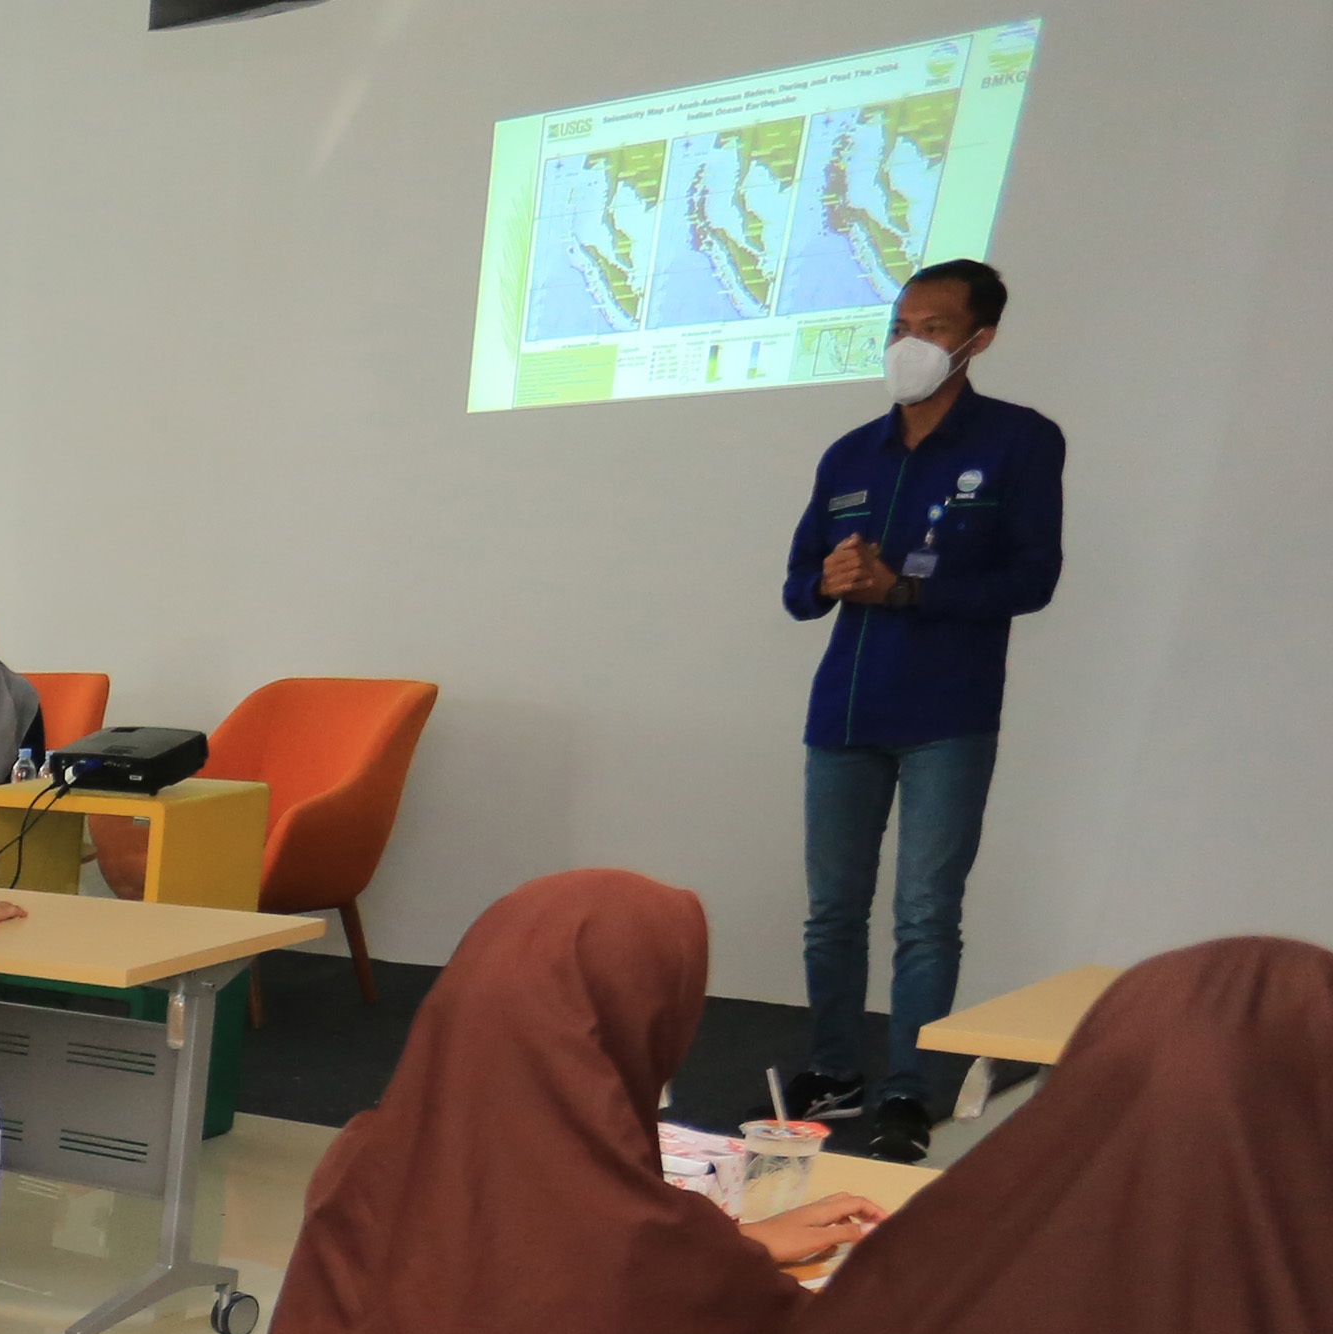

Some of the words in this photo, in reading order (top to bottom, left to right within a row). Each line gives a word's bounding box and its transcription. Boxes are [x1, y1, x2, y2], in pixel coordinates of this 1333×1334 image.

[647, 106, 664, 117] Map
[666, 104, 675, 113] of
[778, 79, 808, 93] During
[809, 76, 828, 87] and
[854, 68, 872, 79] The
[560, 118, 593, 137] USGS
